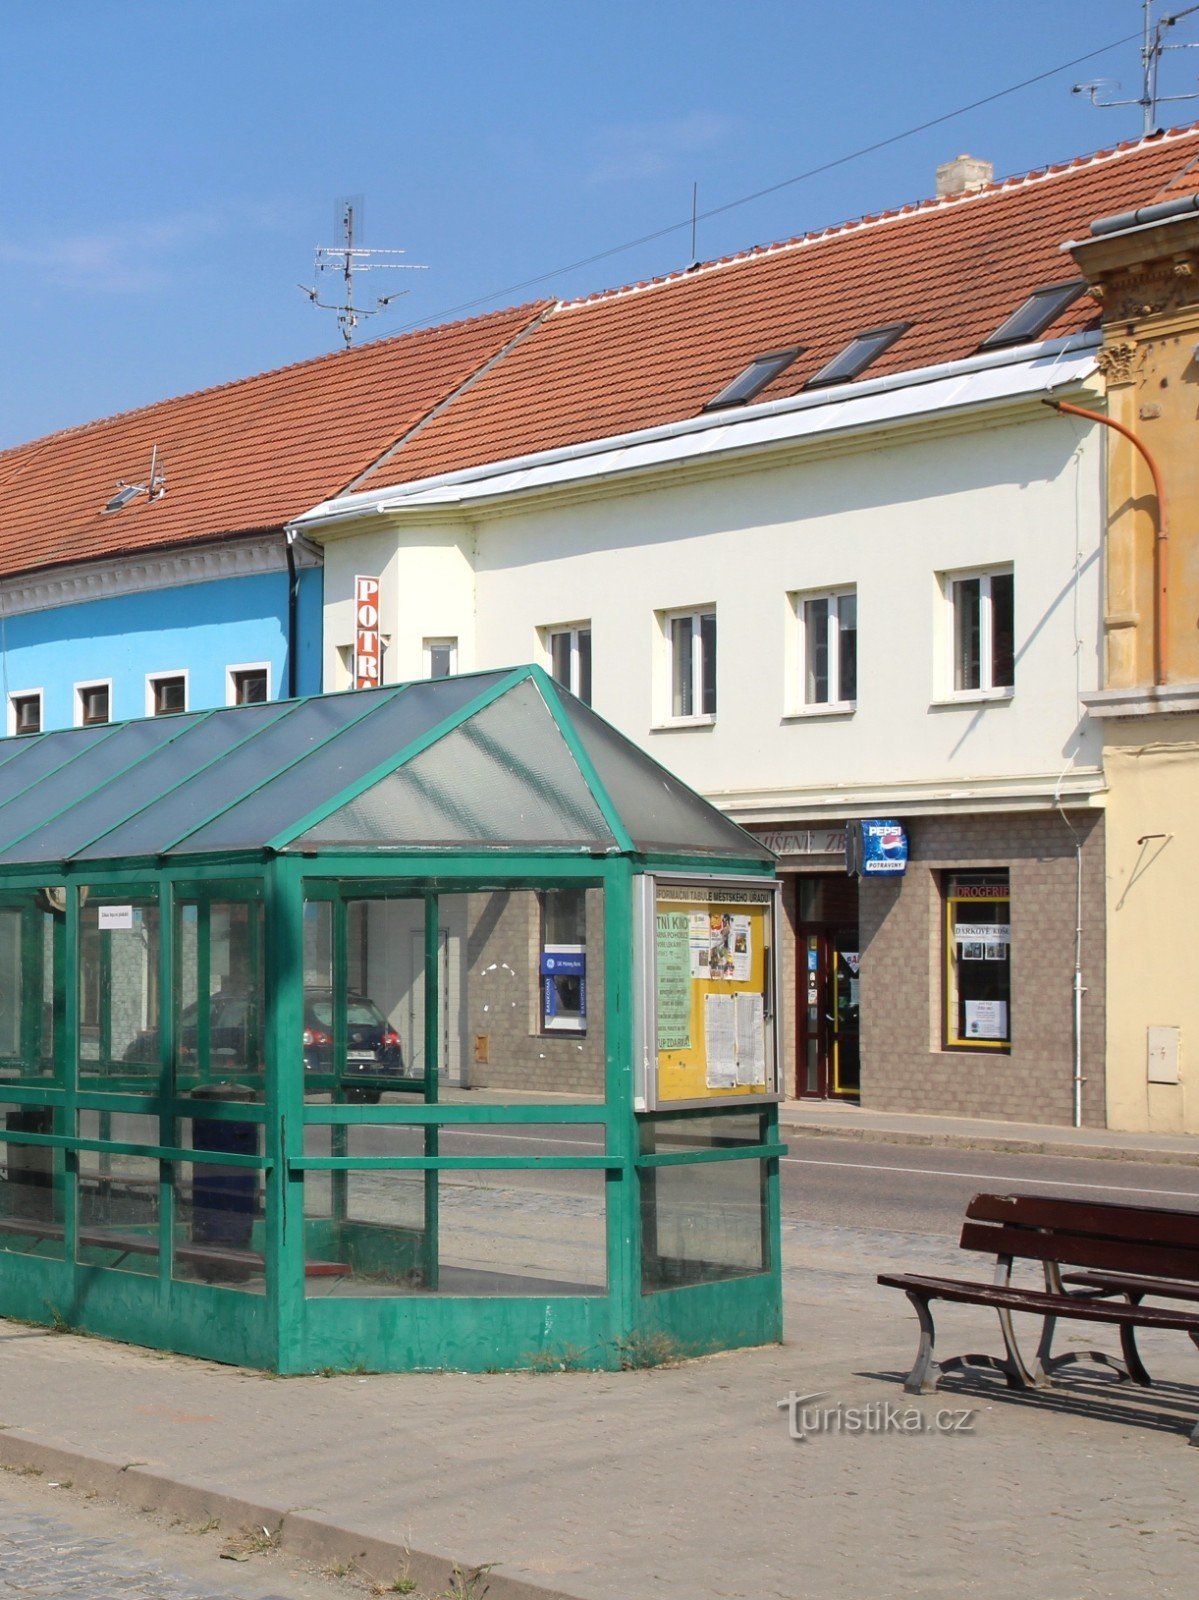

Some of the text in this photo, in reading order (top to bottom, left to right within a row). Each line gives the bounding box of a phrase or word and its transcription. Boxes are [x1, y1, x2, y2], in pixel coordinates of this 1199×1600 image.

[869, 826, 902, 837] PEPSI
[824, 833, 846, 853] ZB
[657, 889, 769, 903] FORMAČNÍ TABULE MĚSTSKÉHO ÚŘADU
[957, 886, 1010, 897] DROGERIE
[955, 926, 992, 935] DÁRKOVÉ
